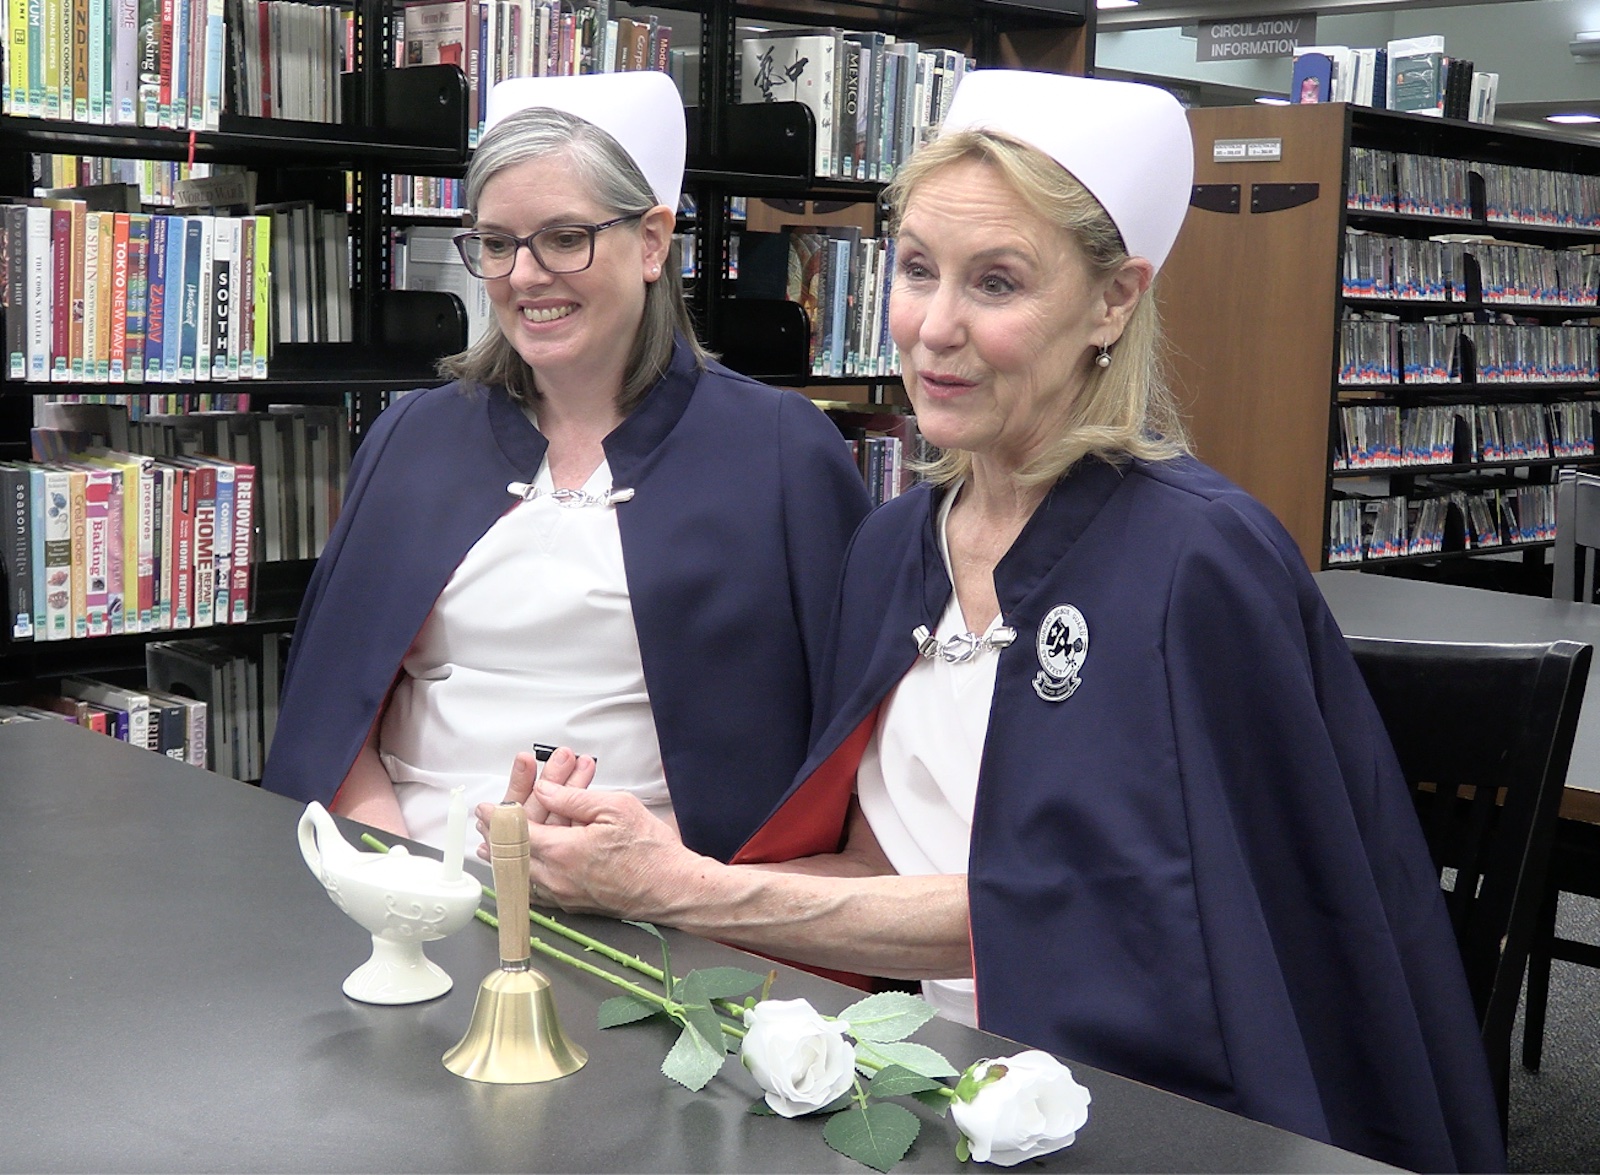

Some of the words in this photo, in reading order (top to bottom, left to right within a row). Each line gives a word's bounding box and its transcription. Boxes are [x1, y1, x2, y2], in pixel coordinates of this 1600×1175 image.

[141, 18, 159, 71] cooking
[161, 24, 171, 66] GREATEST
[1211, 20, 1299, 38] CIRCULATION/
[1211, 39, 1298, 57] INFORMATION
[161, 68, 171, 88] HITS
[470, 49, 479, 75] COUNTRY
[846, 53, 859, 115] MEXICO
[177, 189, 213, 204] WORLD
[86, 234, 98, 282] SPAIN
[115, 241, 127, 288] TOKYO
[114, 289, 125, 321] NEW
[148, 283, 164, 344] ZAHAV
[217, 272, 229, 350] SOUTH
[87, 316, 95, 344] WORLD
[113, 321, 124, 358] WAVE
[243, 333, 251, 352] RECIPE
[16, 484, 25, 535] season
[74, 494, 84, 523] Great
[113, 499, 121, 537] BAKING
[143, 483, 152, 540] preserves
[219, 501, 230, 557] COMPLETE
[234, 481, 253, 567] RENOVATION
[75, 525, 85, 567] Chicken
[88, 519, 103, 577] Baking
[178, 540, 188, 571] HOME
[197, 509, 214, 571] HOME
[113, 559, 121, 588] JULIA
[177, 574, 188, 609] REPAIR
[193, 716, 205, 761] WOOD
